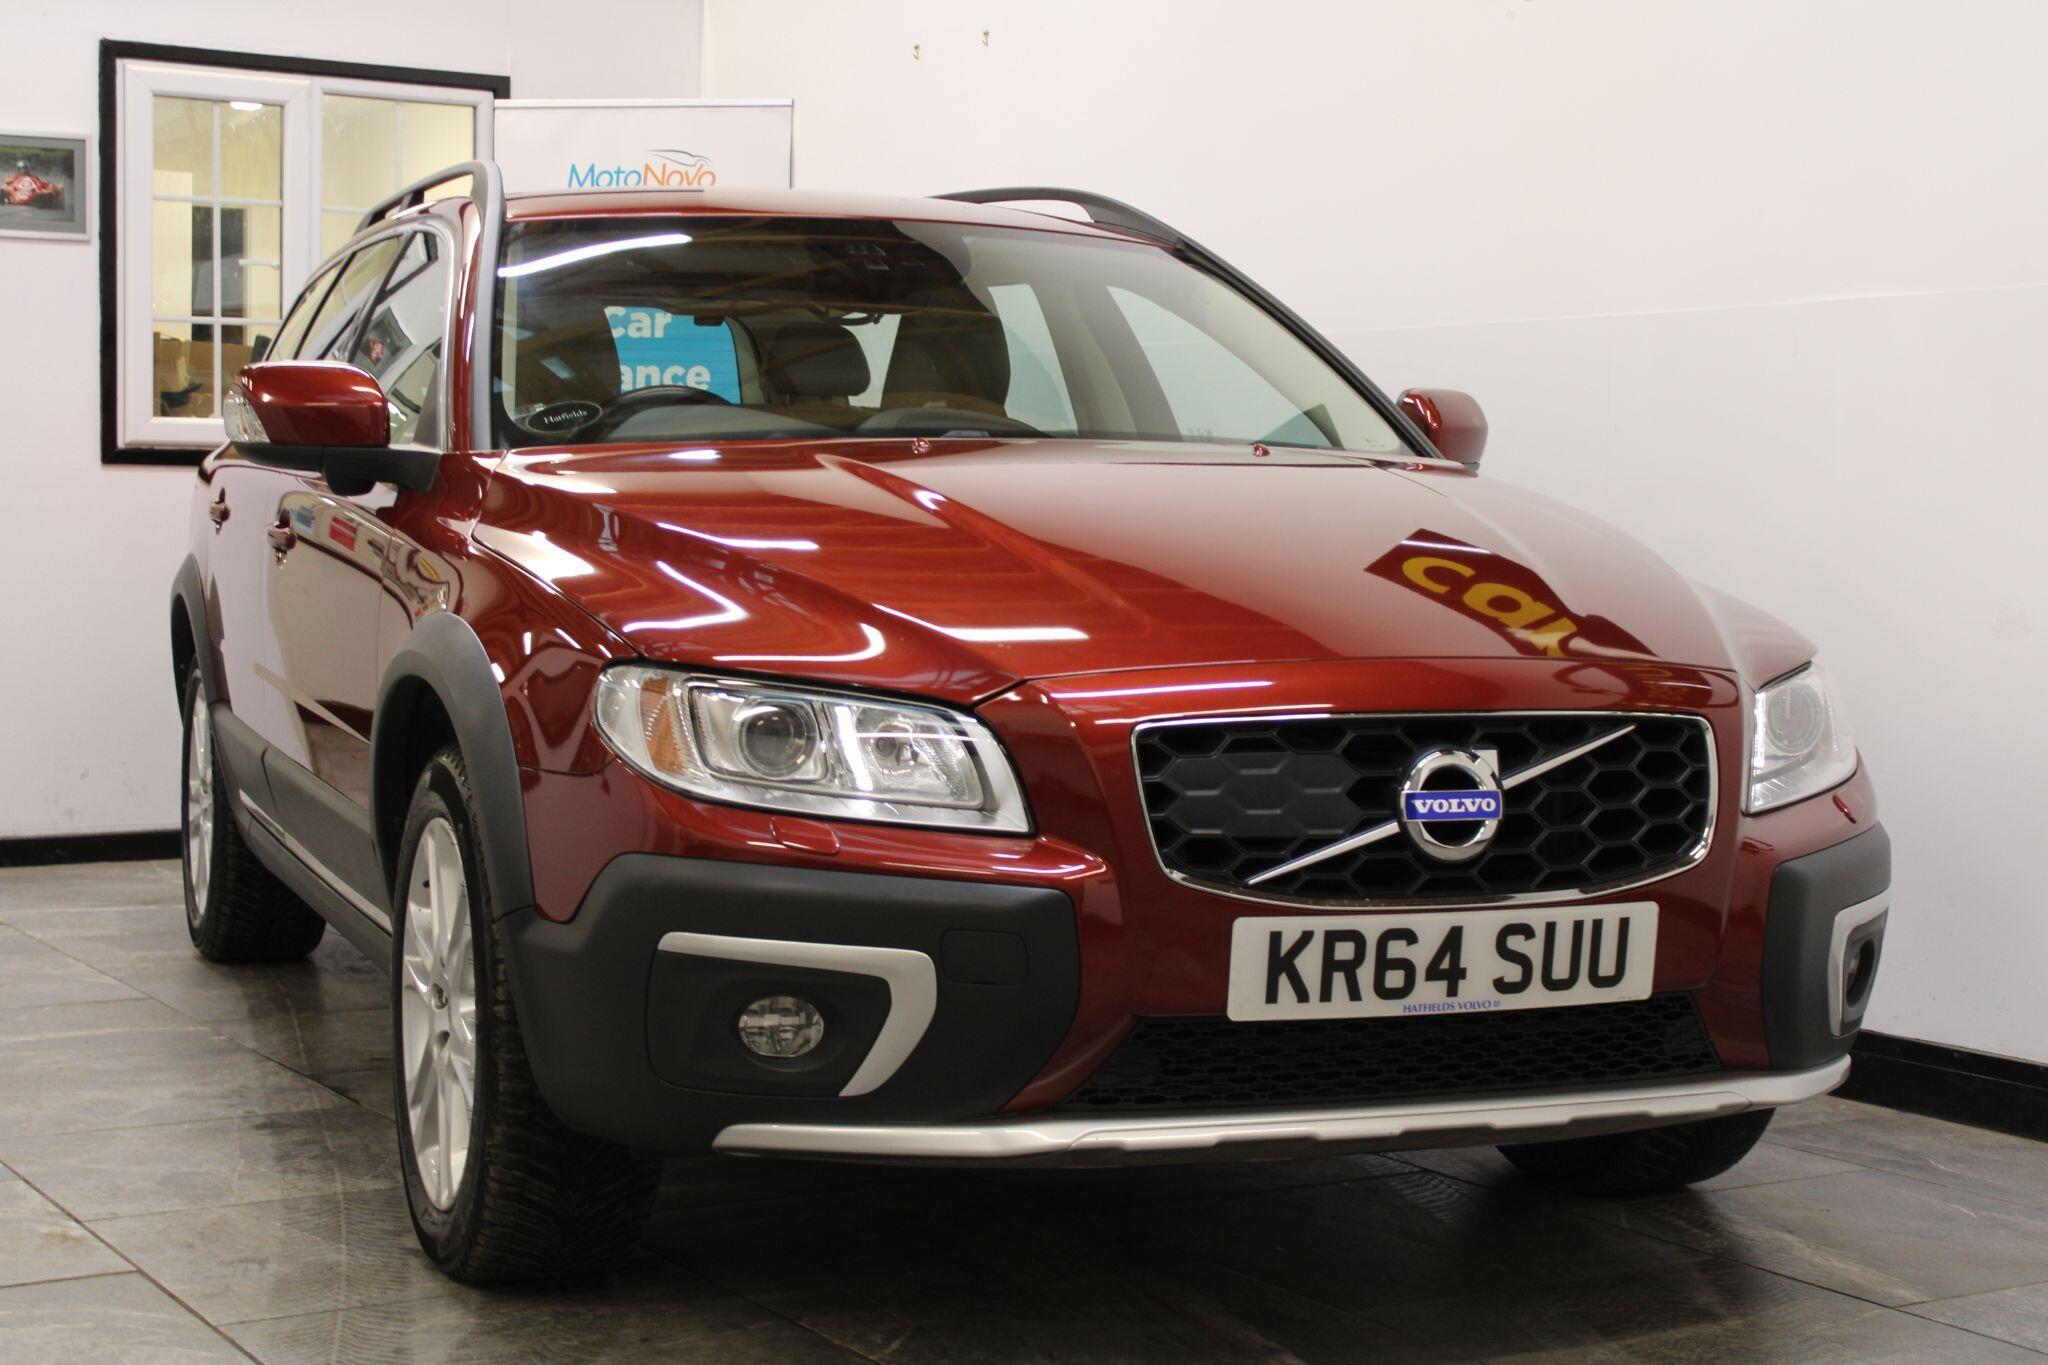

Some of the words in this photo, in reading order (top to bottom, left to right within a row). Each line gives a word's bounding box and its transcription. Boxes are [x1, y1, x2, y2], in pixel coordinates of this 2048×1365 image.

[568, 163, 716, 188] MotoNovo
[1412, 798, 1496, 814] VOLVO
[1265, 926, 1467, 1004] KR64
[1493, 916, 1631, 995] SUU
[1403, 1001, 1456, 1013] HATFIELDS
[1457, 1000, 1492, 1010] VOLVO
